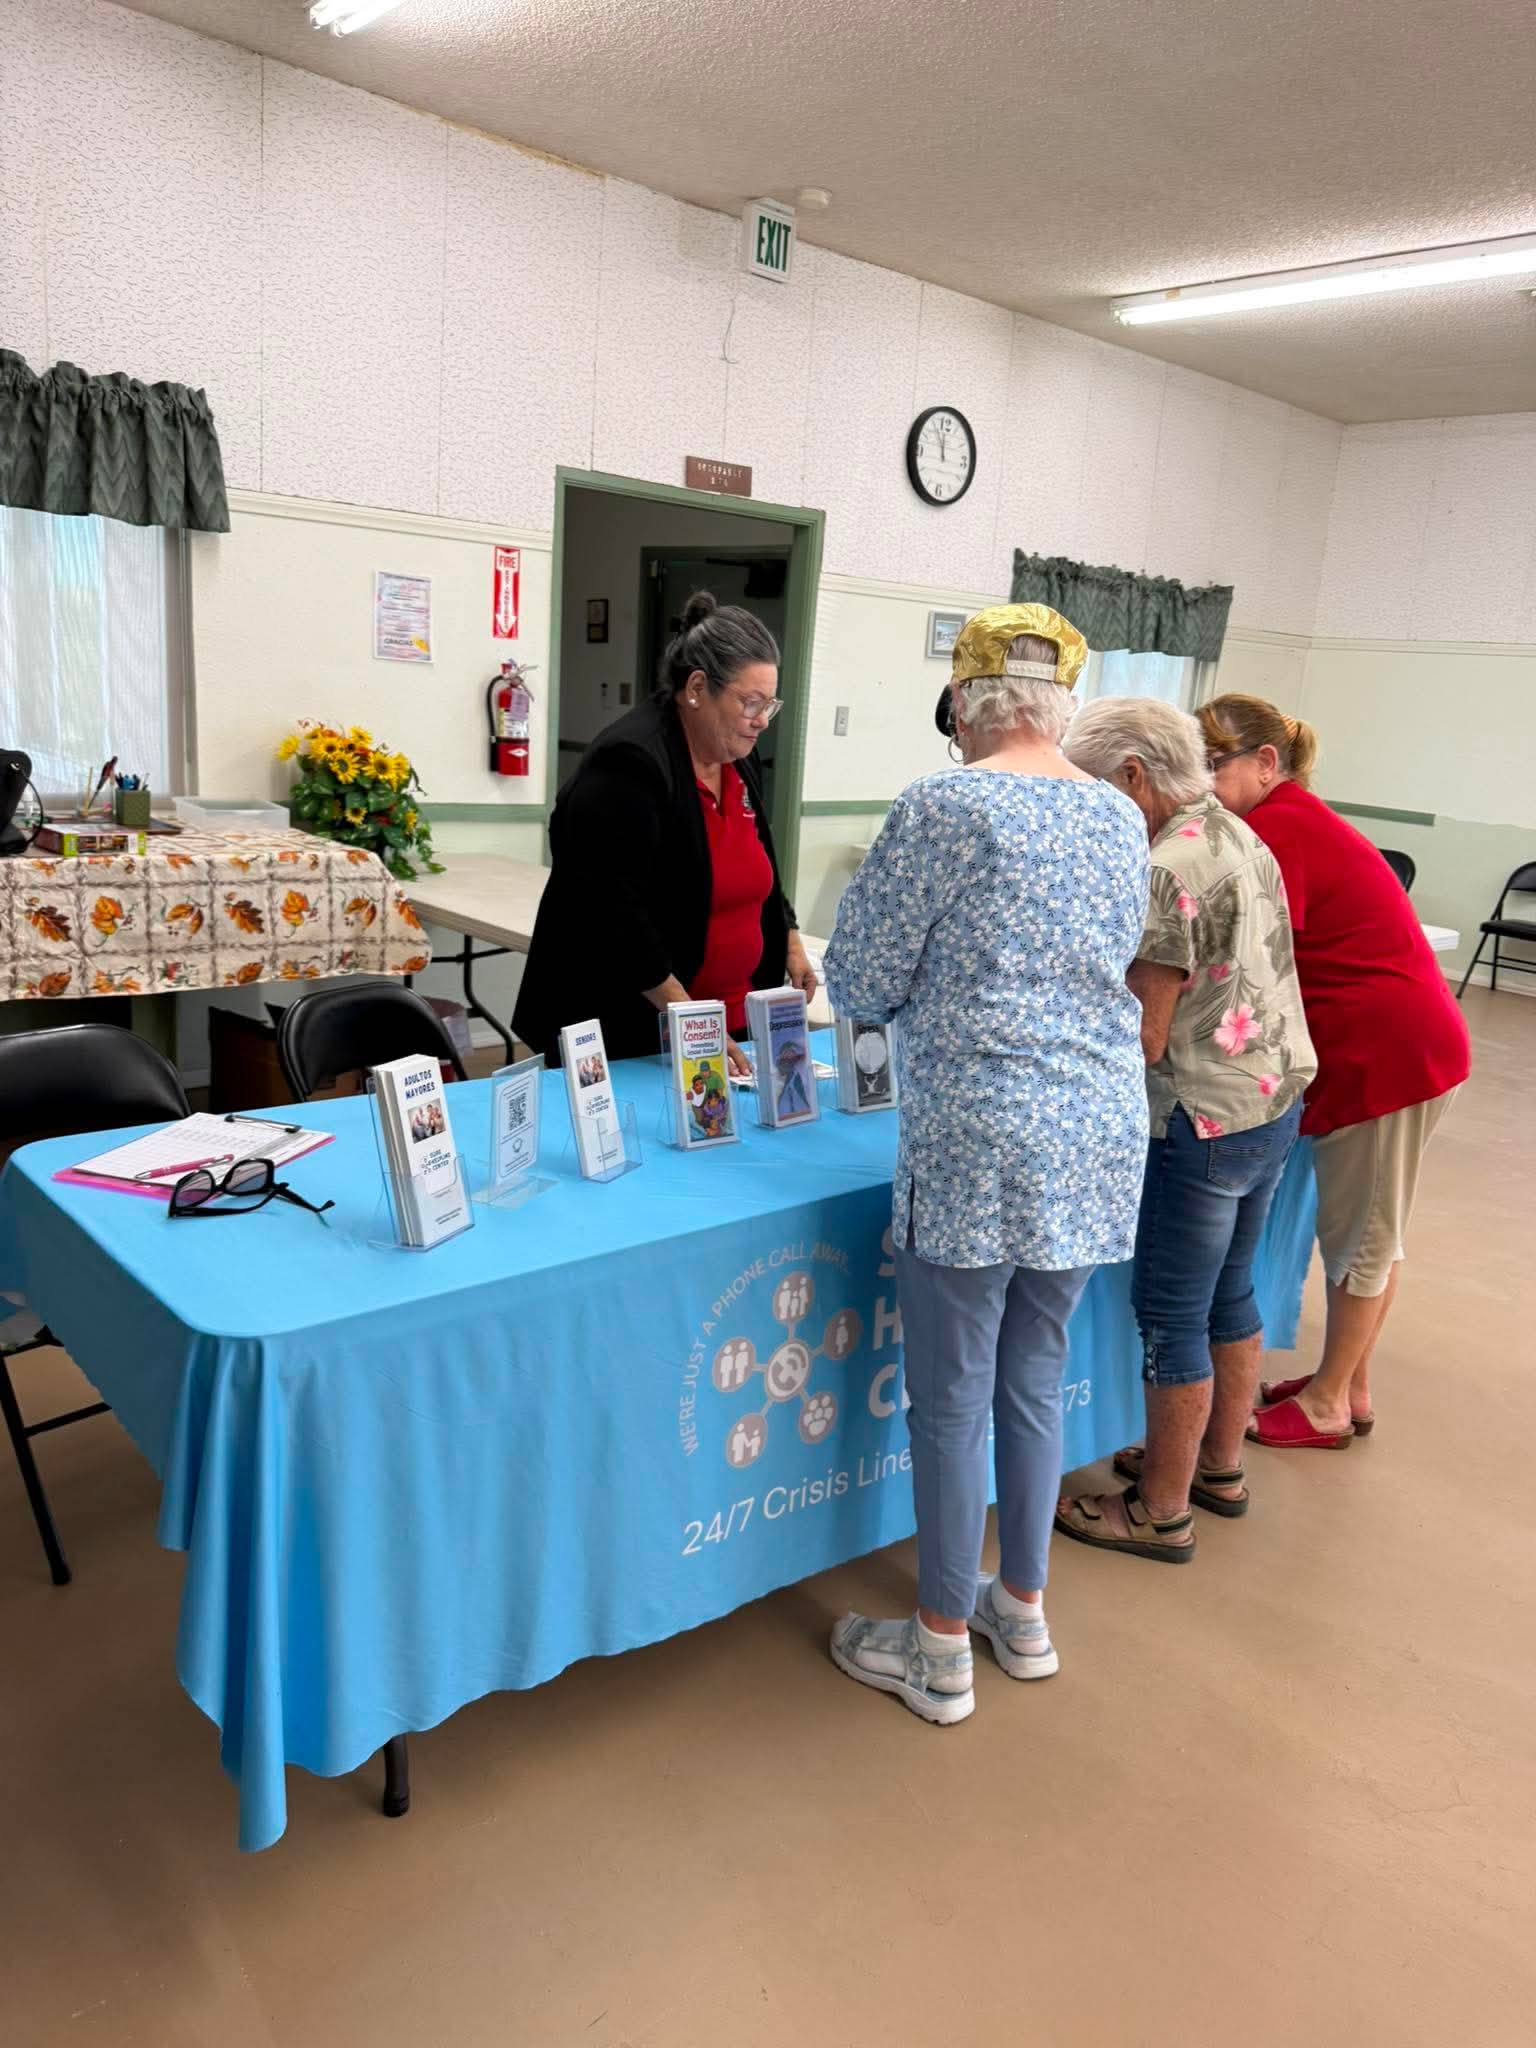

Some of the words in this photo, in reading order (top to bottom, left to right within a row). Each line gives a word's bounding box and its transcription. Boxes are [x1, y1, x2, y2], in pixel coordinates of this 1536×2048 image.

[756, 214, 792, 273] EXIT
[940, 416, 952, 432] 12
[960, 455, 968, 470] 3
[935, 483, 943, 498] 6
[499, 555, 517, 569] FIRE
[684, 1019, 707, 1031] What
[709, 1017, 719, 1029] Is
[683, 1028, 721, 1042] Consent?
[404, 1069, 432, 1087] ADULTOS
[405, 1081, 436, 1100] MAYORES
[682, 1336, 707, 1389] JUST
[702, 1321, 717, 1336] A
[711, 1258, 767, 1317] PHONE
[768, 1240, 805, 1268] CALL
[1063, 1378, 1092, 1412] 73
[682, 1496, 755, 1556] 24/7
[763, 1467, 849, 1520] Crisis
[857, 1447, 913, 1487] Line
